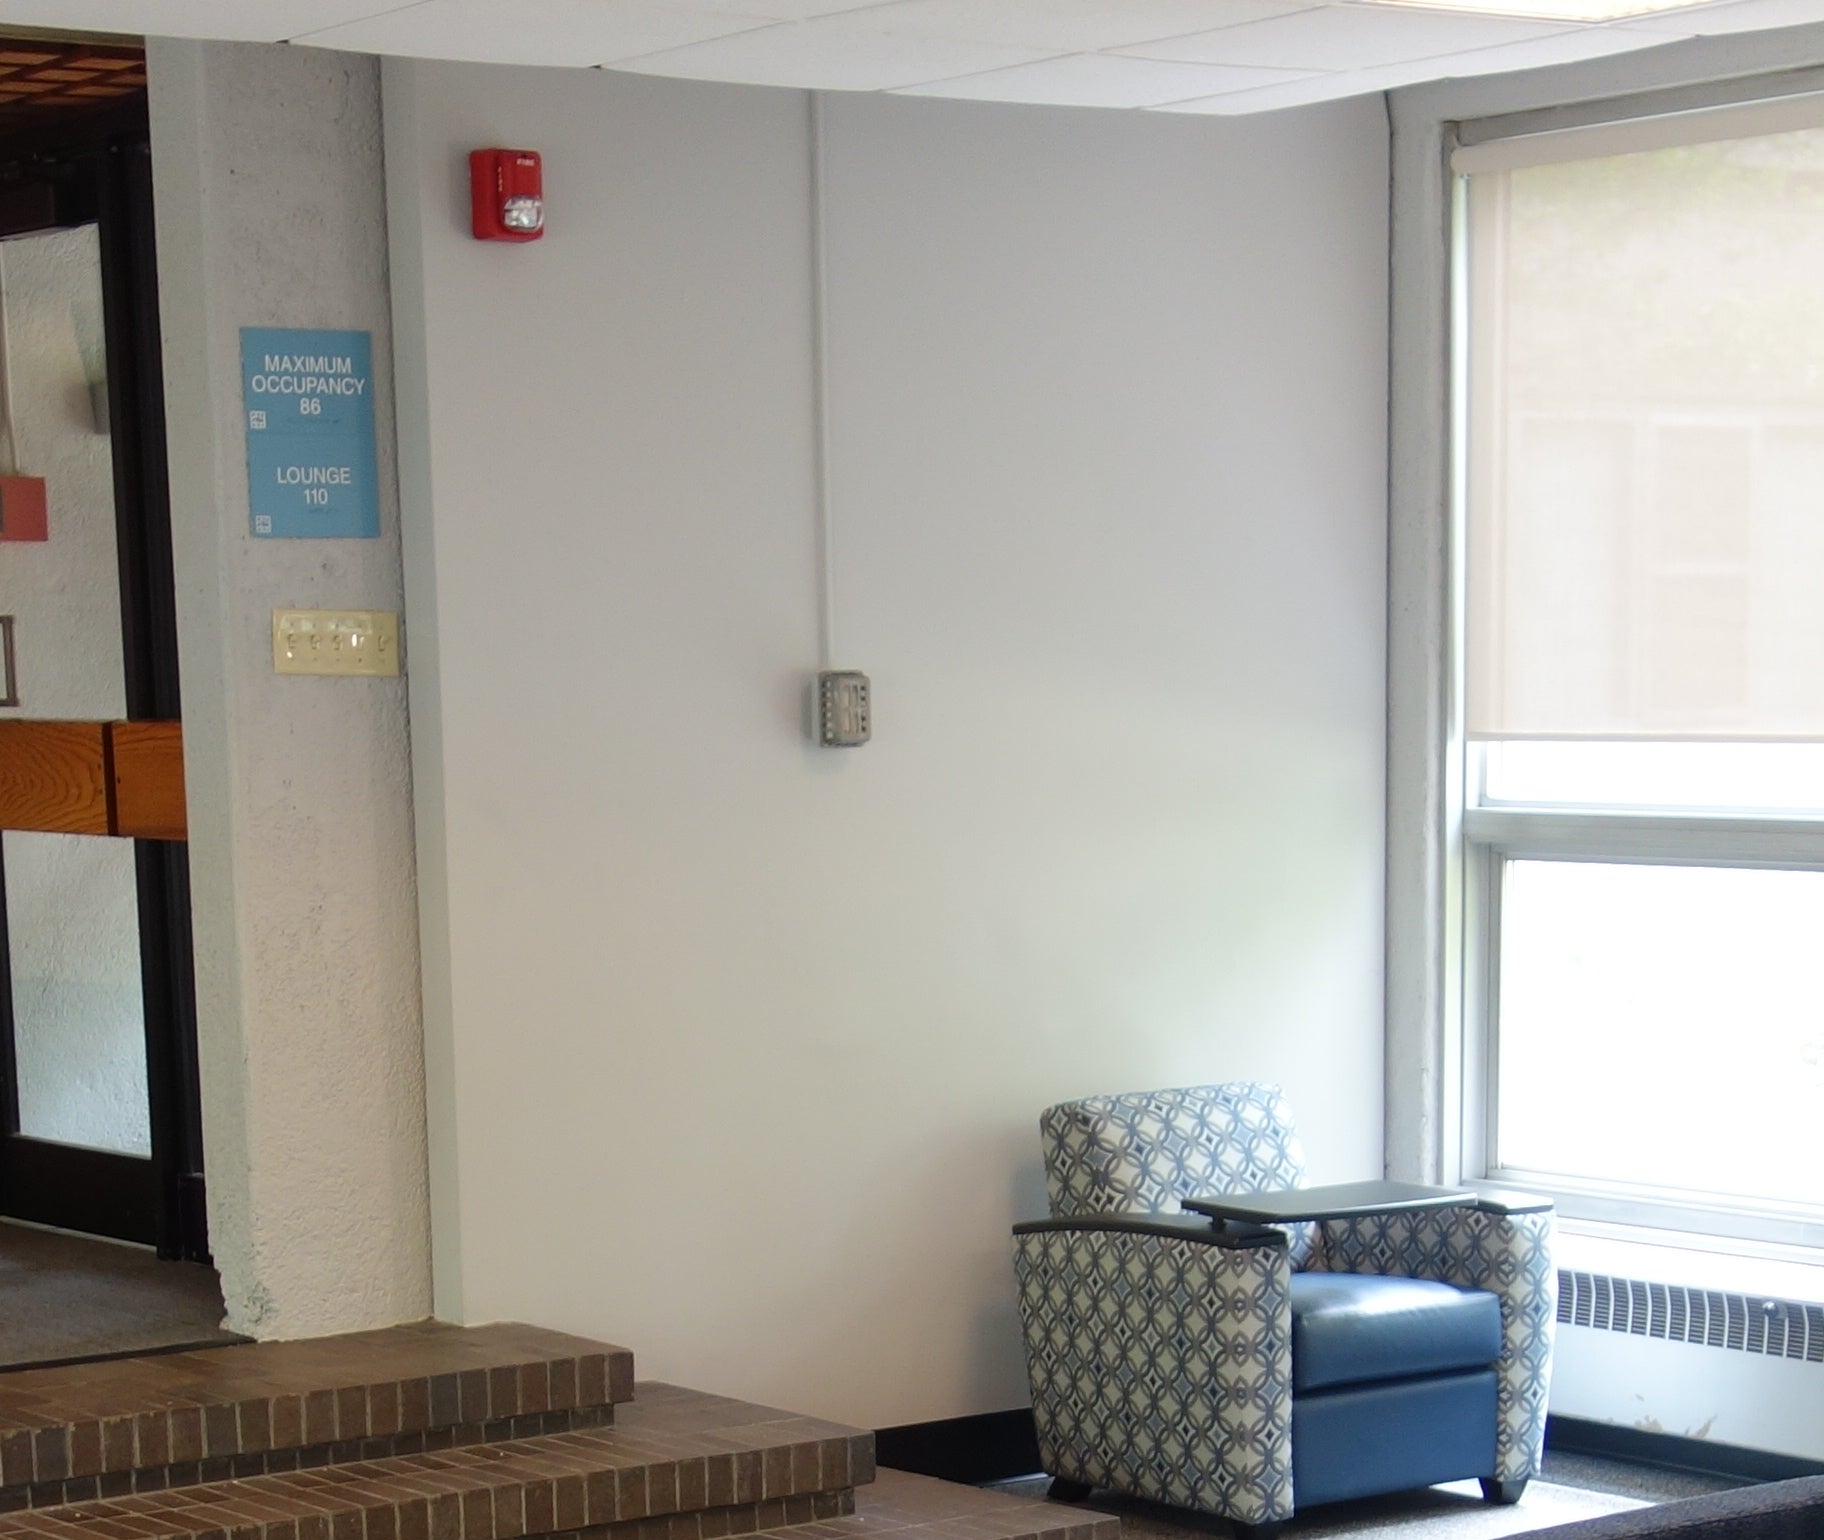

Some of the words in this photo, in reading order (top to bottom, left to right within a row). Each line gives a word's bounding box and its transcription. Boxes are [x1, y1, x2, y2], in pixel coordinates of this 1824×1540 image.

[264, 354, 352, 374] MAXIMUM
[252, 375, 365, 395] OCCUPANCY
[300, 398, 321, 415] 86
[277, 466, 351, 485] LOUNGE
[304, 488, 328, 505] 110
